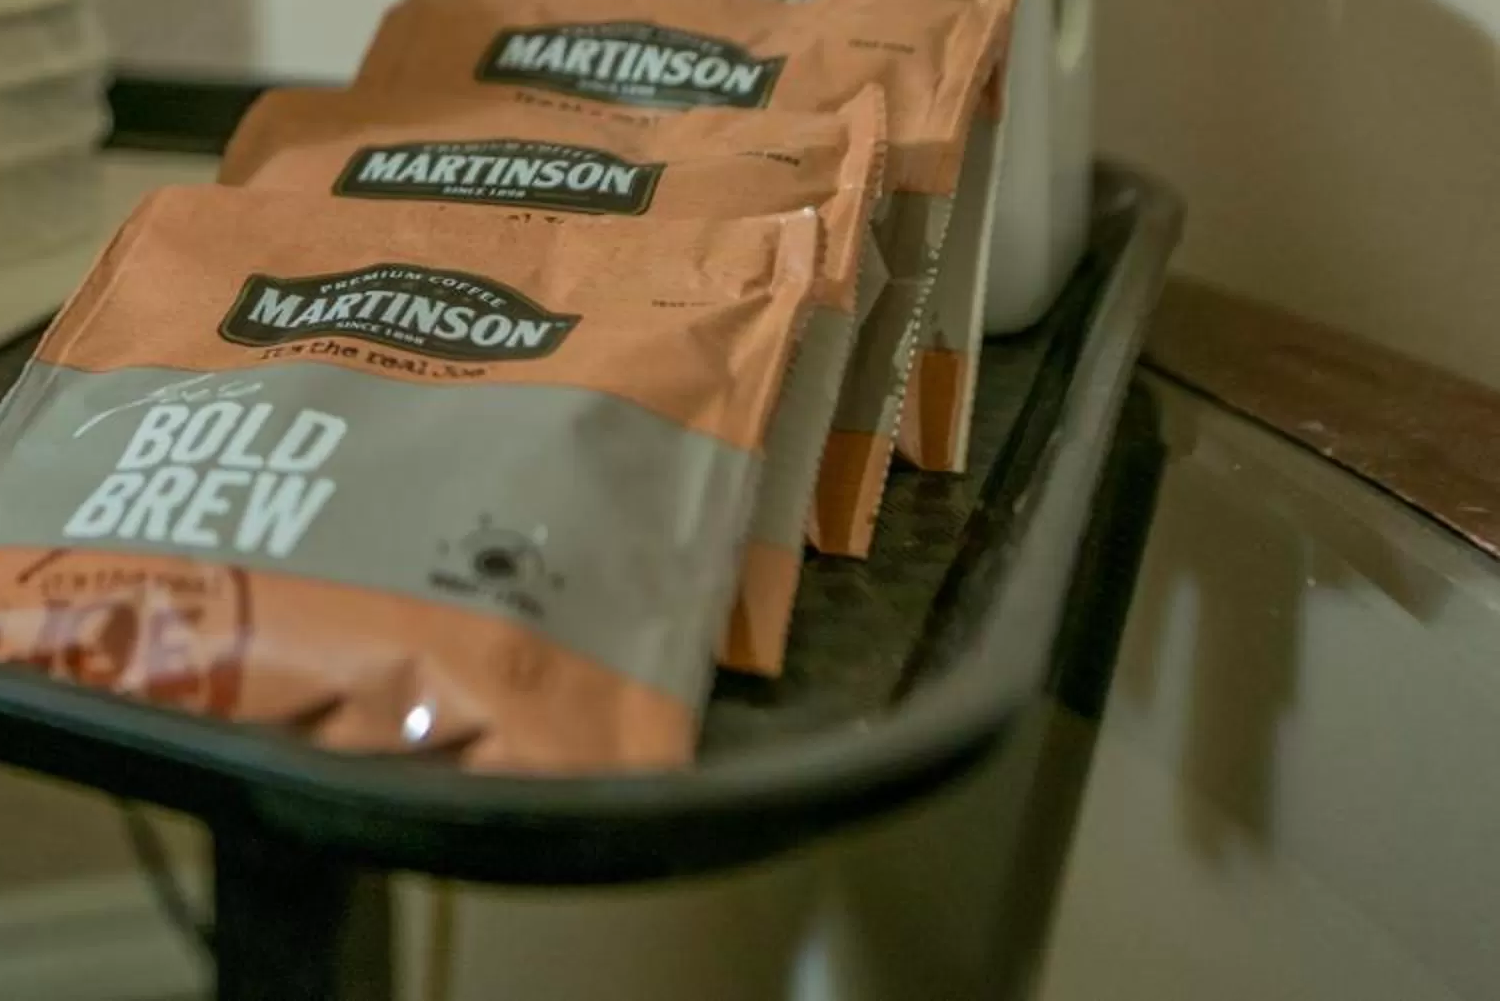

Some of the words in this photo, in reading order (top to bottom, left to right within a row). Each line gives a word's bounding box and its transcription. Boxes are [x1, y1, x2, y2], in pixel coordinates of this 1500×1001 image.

[496, 34, 764, 93] MARTINSON
[358, 151, 640, 195] MARTINSON
[320, 270, 422, 294] PREMIUM
[428, 275, 507, 309] COFFEE
[247, 286, 553, 349] MARTINSON
[335, 320, 382, 333] SINCE
[308, 340, 360, 358] the
[365, 350, 429, 376] real
[116, 401, 348, 473] BOLD
[61, 465, 338, 559] BREW
